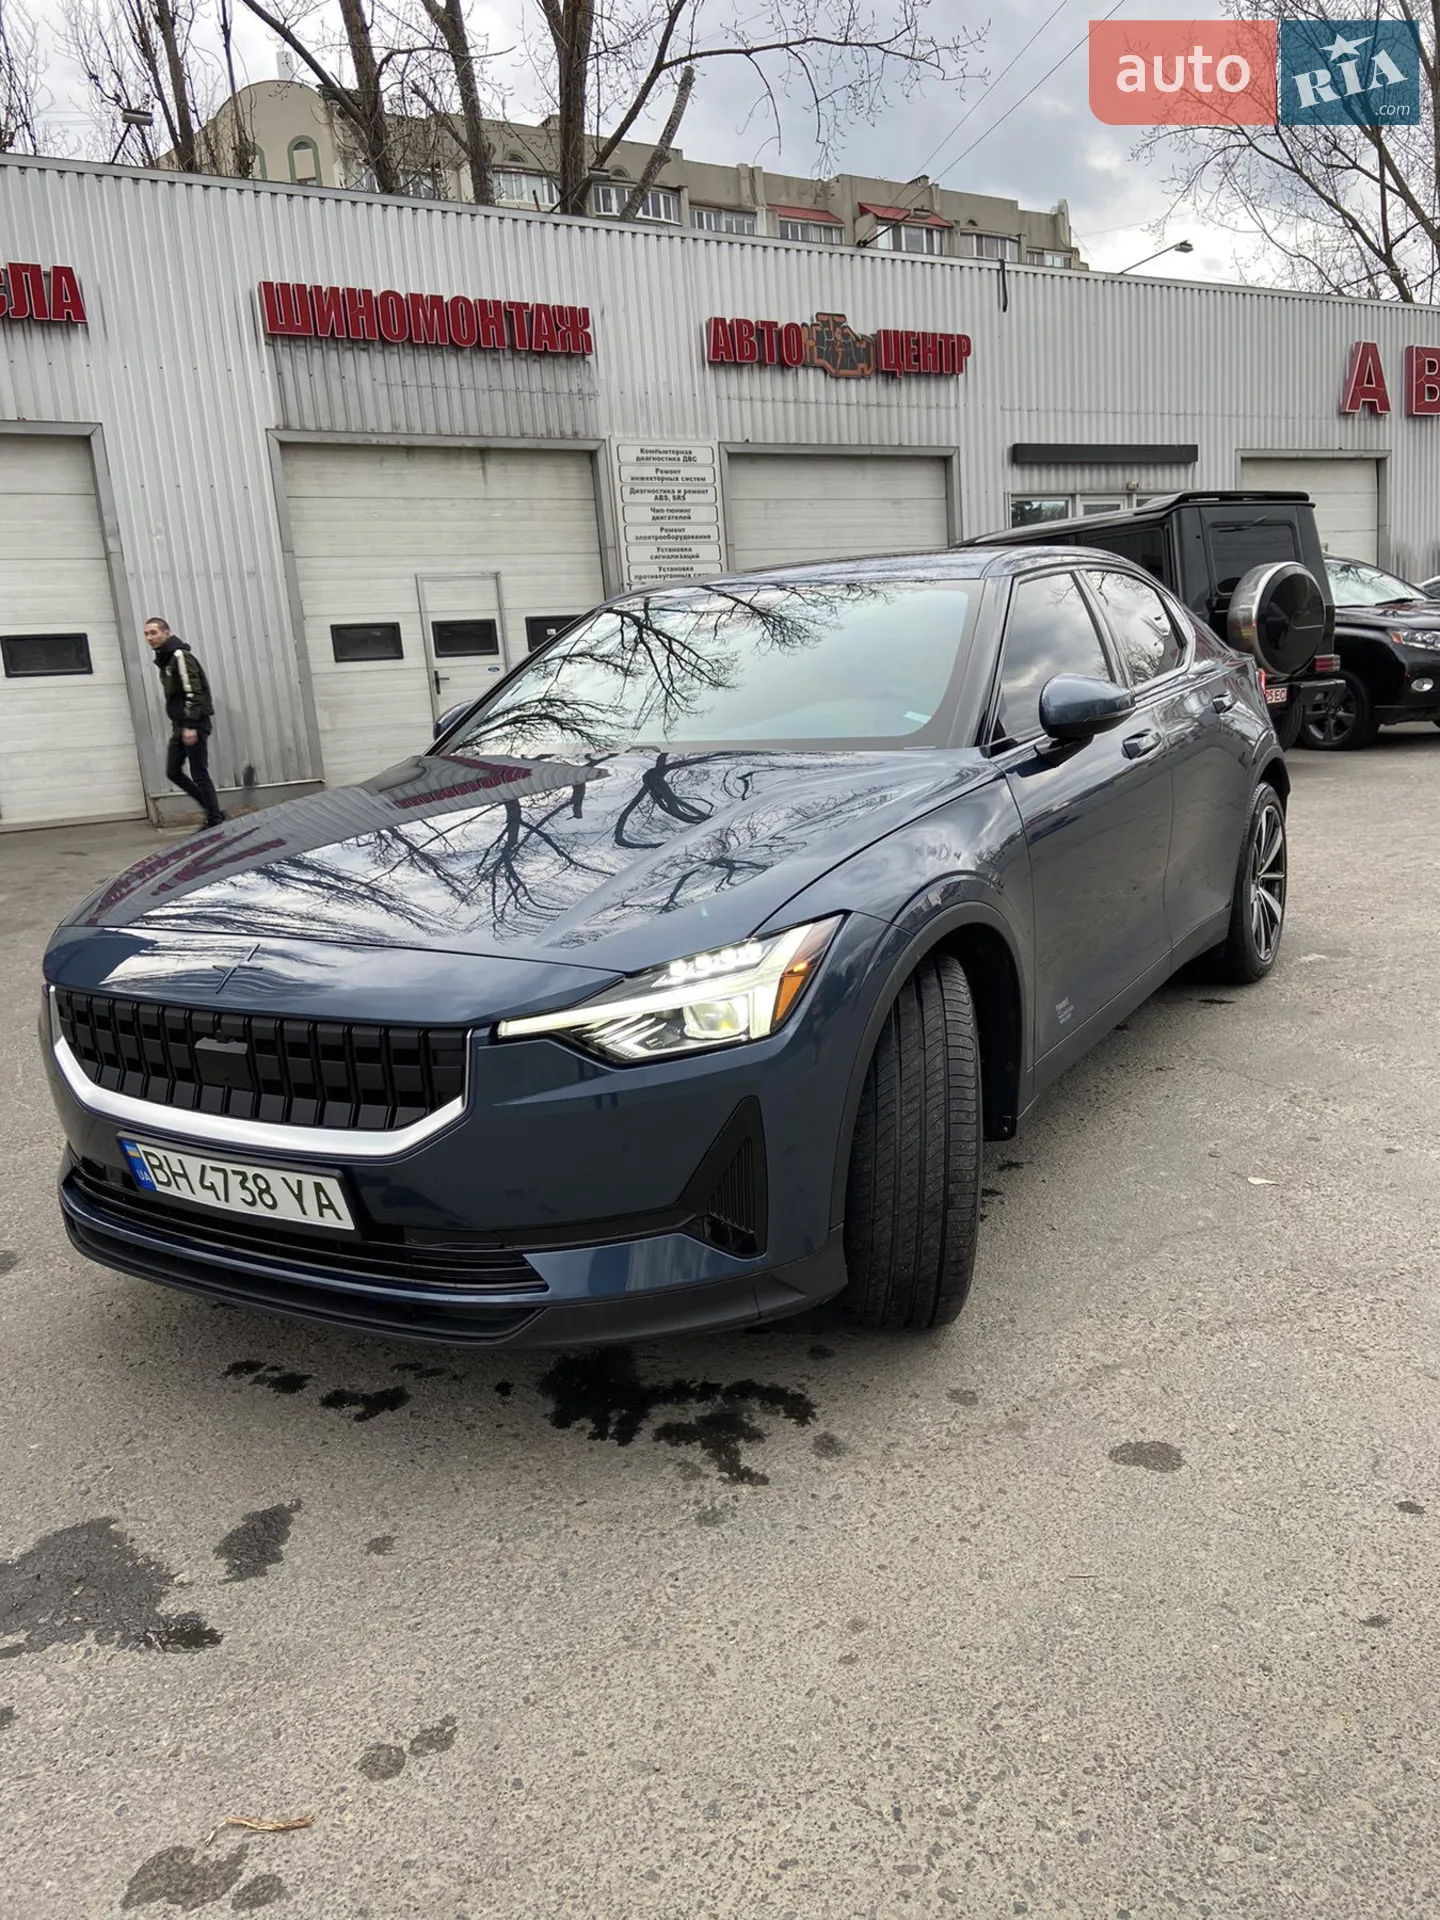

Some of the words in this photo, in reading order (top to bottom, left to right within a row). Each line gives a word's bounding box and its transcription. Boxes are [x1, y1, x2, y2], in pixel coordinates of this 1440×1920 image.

[0, 261, 88, 323] ЛА
[258, 281, 593, 356] ШИНОМОНТАЖ
[707, 317, 804, 368] АВТО
[877, 329, 972, 378] ЦЕНТР
[682, 455, 698, 463] ДВС
[655, 467, 681, 475] Ремонт
[629, 487, 675, 495] Диагностика
[684, 488, 708, 496] ремонт
[660, 526, 685, 534] Ремонт
[137, 1168, 151, 1182] UA
[141, 1150, 197, 1196] BH
[199, 1164, 278, 1210] 4738
[281, 1176, 344, 1221] YA
